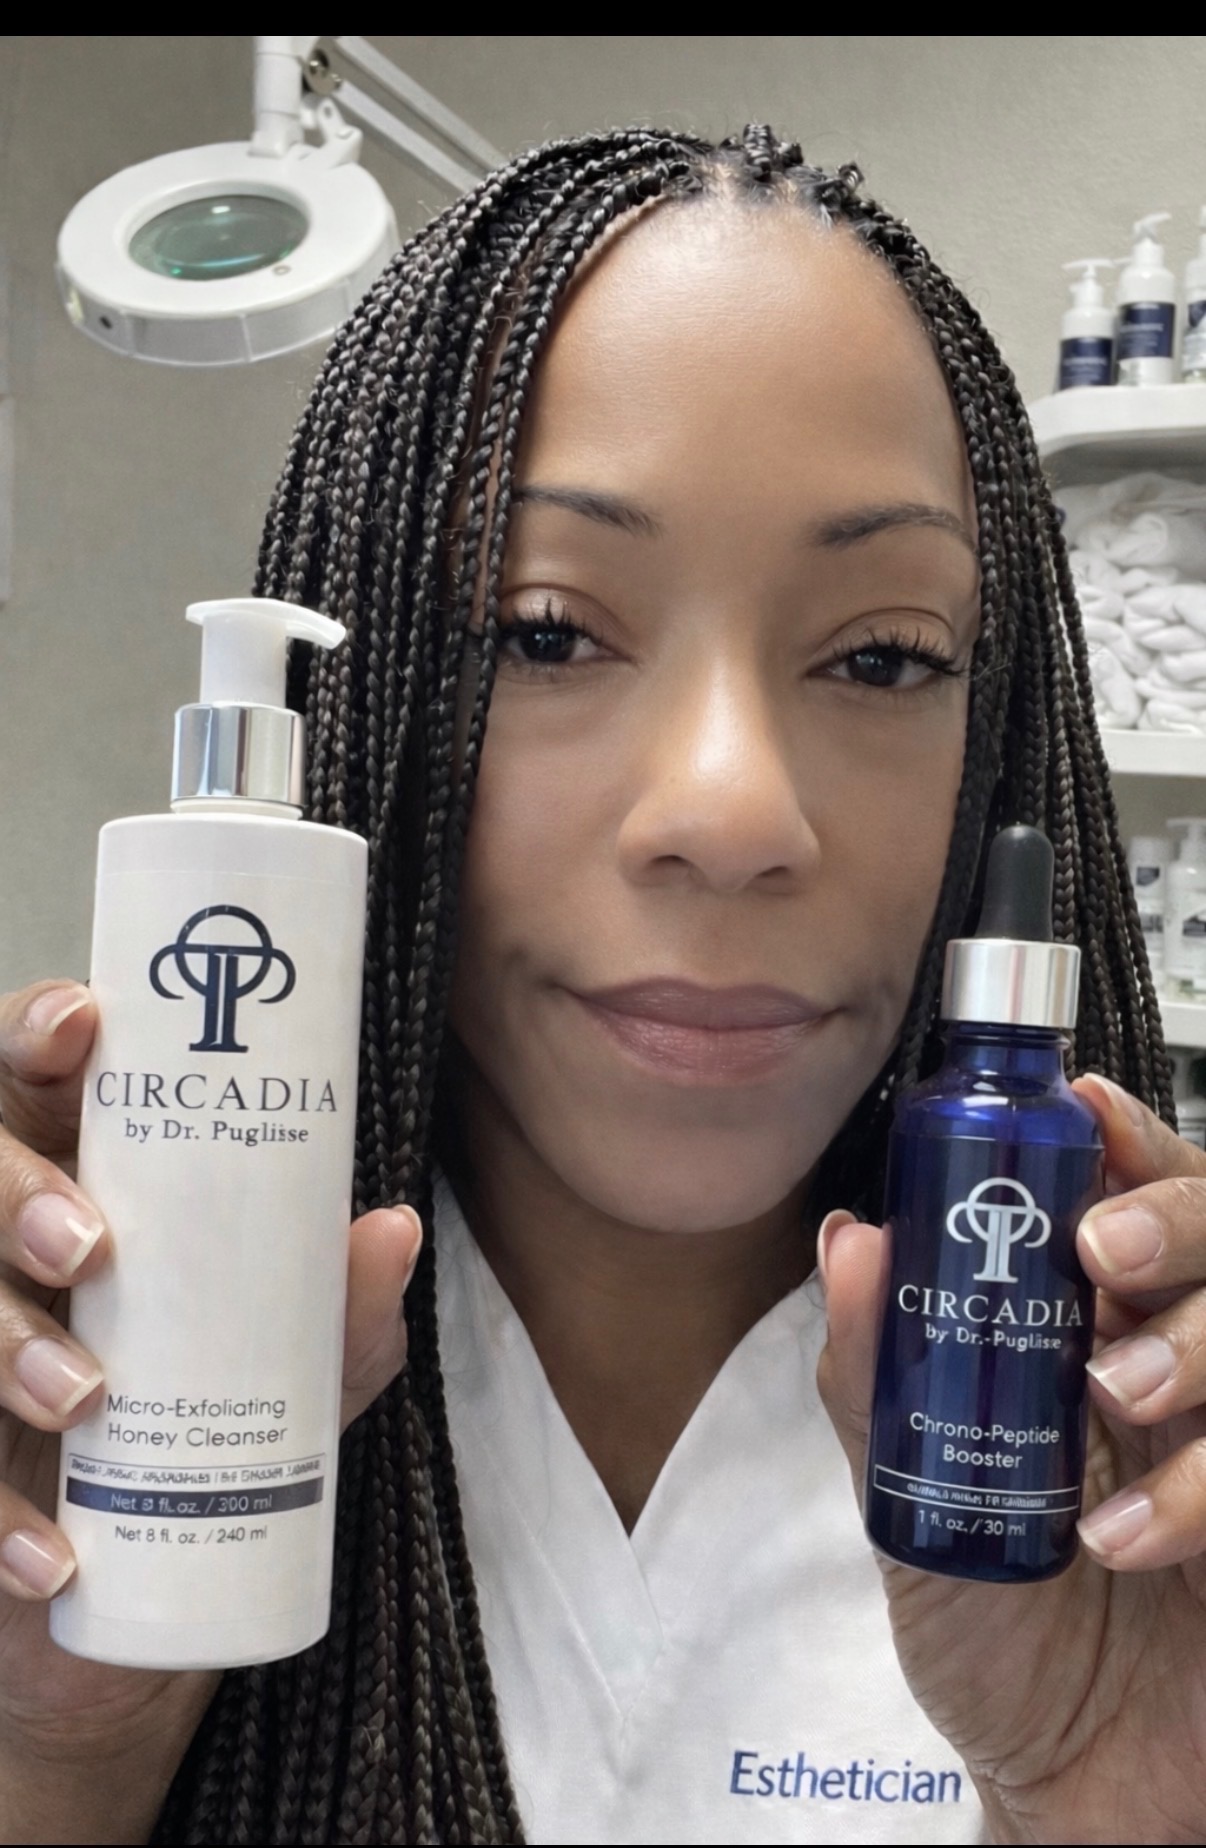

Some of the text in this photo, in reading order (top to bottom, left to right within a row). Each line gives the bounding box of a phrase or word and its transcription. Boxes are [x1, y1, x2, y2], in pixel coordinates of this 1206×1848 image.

[96, 1071, 338, 1112] CIRCADIA
[125, 1118, 152, 1143] by
[162, 1119, 201, 1140] Dr.
[898, 1284, 1083, 1327] CIRCADIA
[925, 1323, 948, 1344] by
[107, 1394, 286, 1418] Micro-Exfoliating
[108, 1422, 288, 1449] Honey Cleanser
[909, 1411, 1061, 1448] Chrono-Peptide
[943, 1444, 1023, 1469] Booster
[110, 1494, 137, 1511] Net
[252, 1494, 273, 1510] ml
[115, 1525, 142, 1543] Net
[146, 1528, 156, 1543] 8
[178, 1532, 200, 1545] oz.
[216, 1526, 246, 1544] 240
[250, 1525, 268, 1541] ml
[918, 1510, 925, 1524] 1
[984, 1519, 1004, 1536] 30
[1008, 1522, 1027, 1537] ml
[730, 1750, 962, 1803] Esthetician
